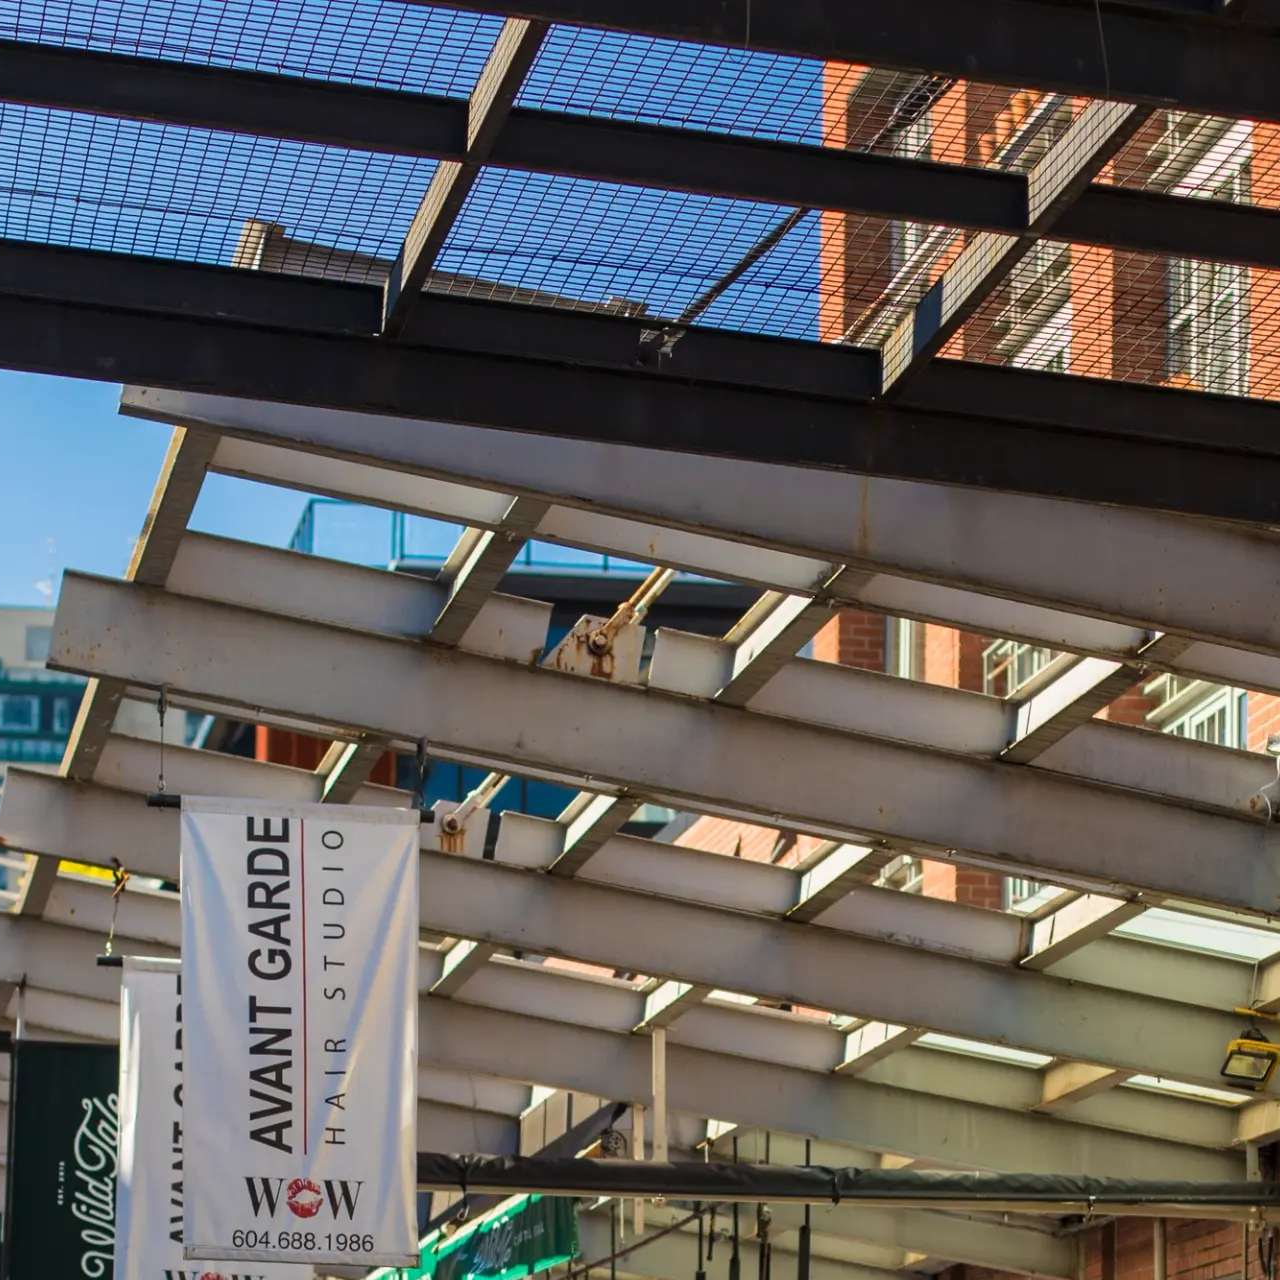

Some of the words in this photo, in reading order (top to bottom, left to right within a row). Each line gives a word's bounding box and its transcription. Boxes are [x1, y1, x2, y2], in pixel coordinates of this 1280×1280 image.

[247, 816, 292, 980] GARDE
[322, 829, 346, 1001] STUDIO
[249, 995, 293, 1154] AVANT
[325, 1038, 347, 1145] HAIR
[71, 1169, 116, 1278] Wild
[232, 1229, 374, 1252] 604.688.1986
